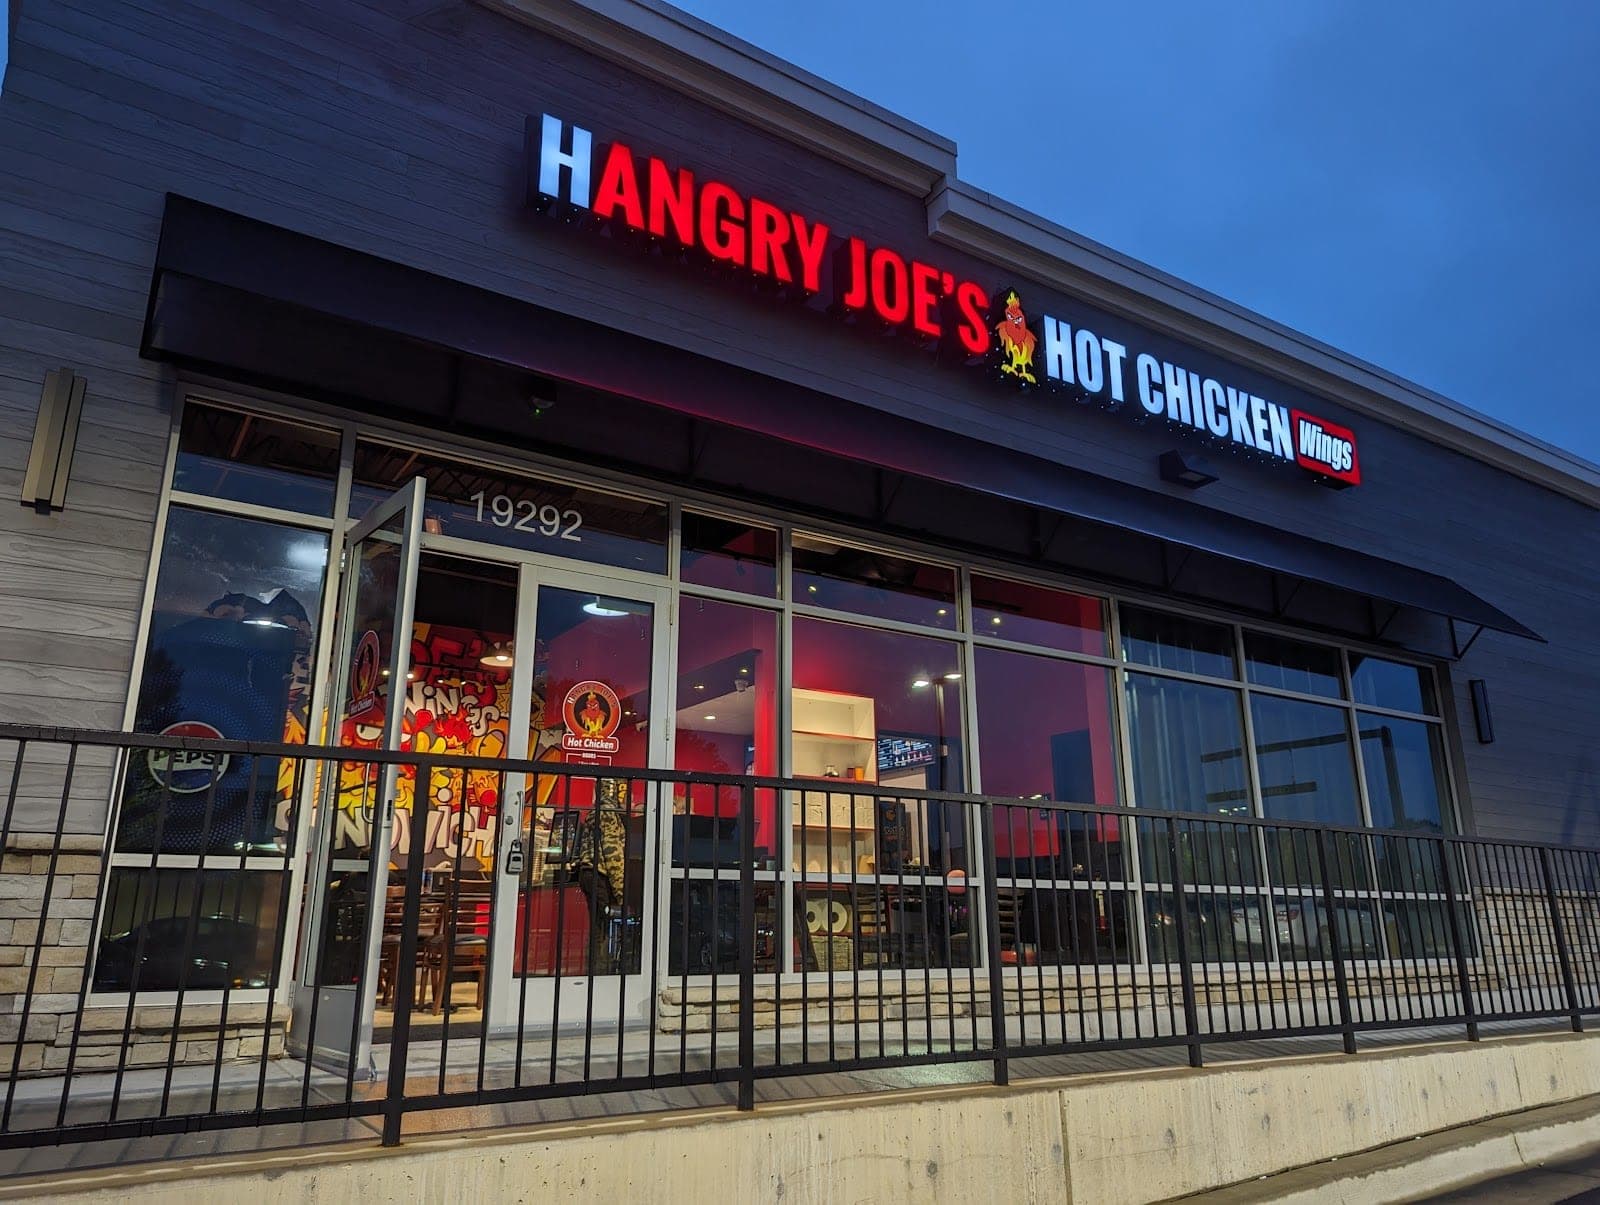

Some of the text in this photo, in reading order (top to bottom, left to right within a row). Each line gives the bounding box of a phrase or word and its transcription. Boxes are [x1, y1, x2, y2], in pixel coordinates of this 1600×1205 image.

[538, 112, 1354, 471] HANGRY JOE'S HOT CHICKEN Wings
[470, 490, 583, 542] 19292
[567, 736, 614, 750] Hot Chicken
